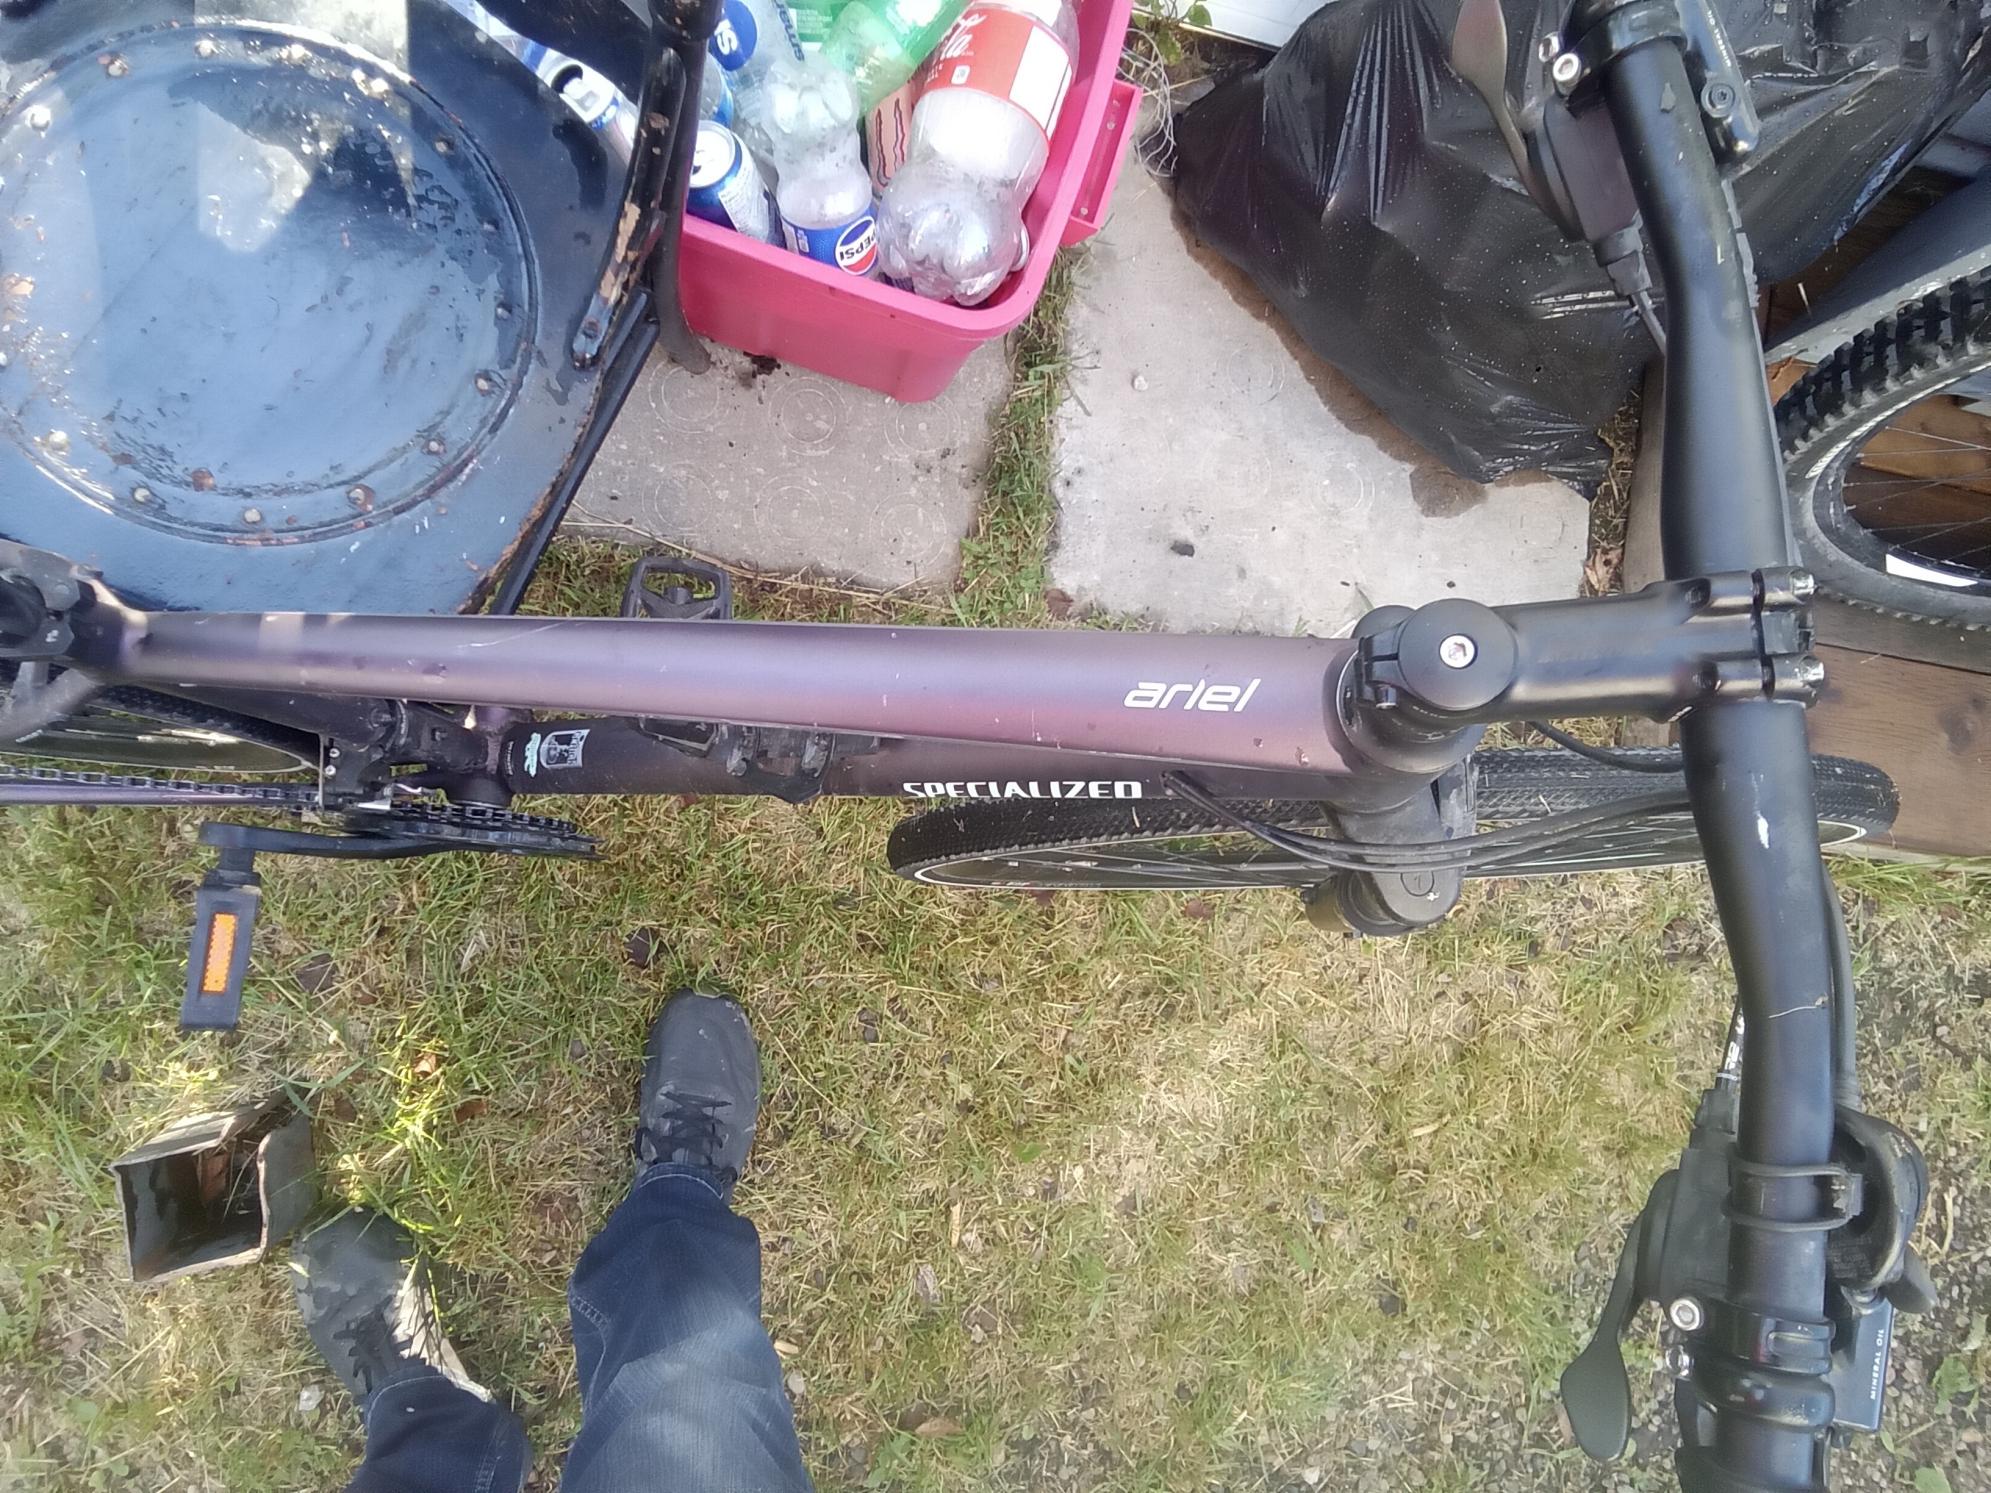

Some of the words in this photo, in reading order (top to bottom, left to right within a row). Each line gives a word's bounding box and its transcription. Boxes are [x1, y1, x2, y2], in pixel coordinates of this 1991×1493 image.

[839, 228, 876, 262] PEPSI
[1123, 678, 1262, 713] ariel
[902, 781, 1143, 799] SPECIALIZED
[1869, 1351, 1882, 1401] MINERAL
[1876, 1328, 1885, 1347] OIL
